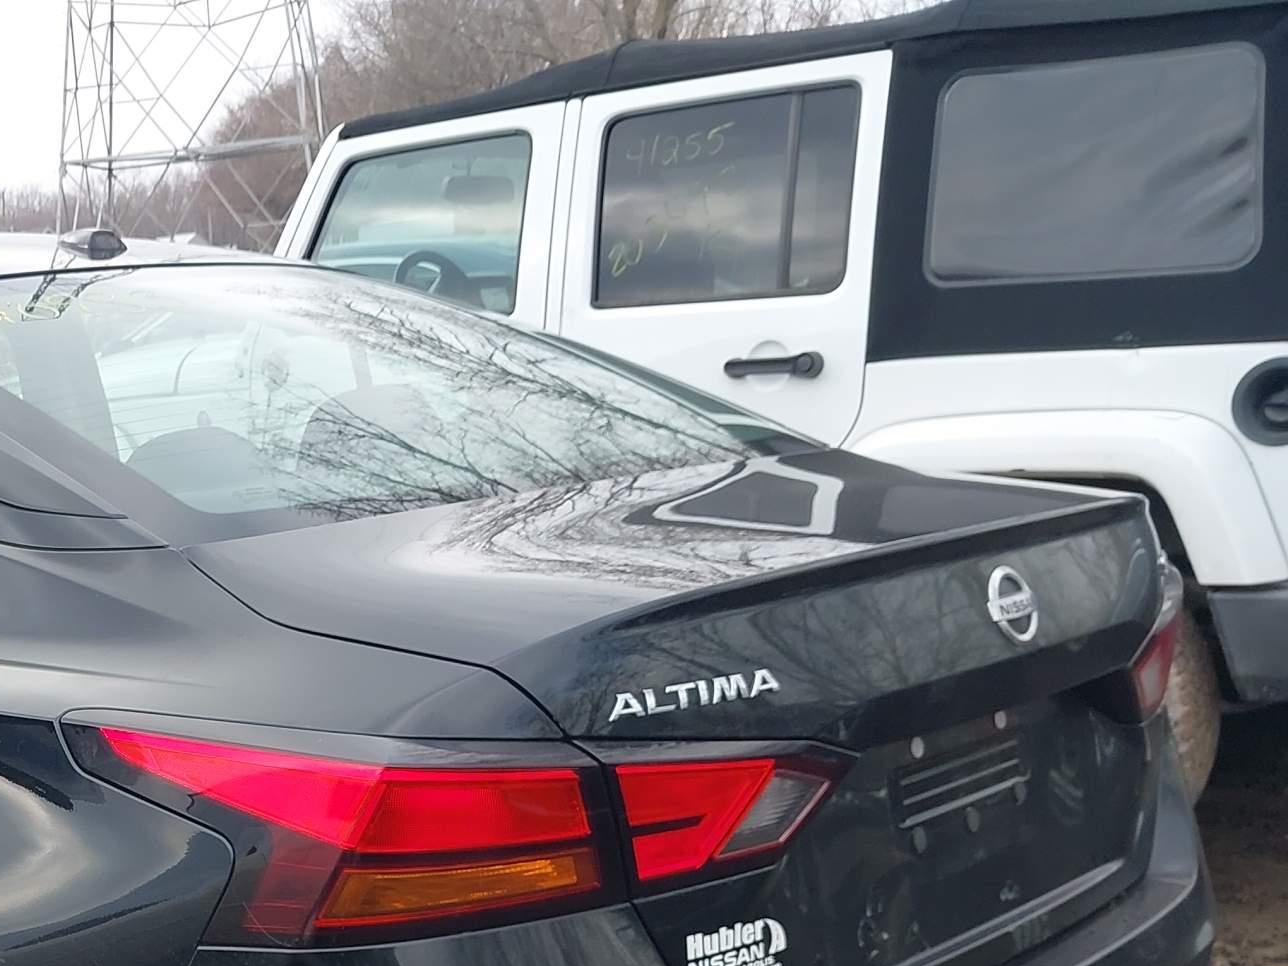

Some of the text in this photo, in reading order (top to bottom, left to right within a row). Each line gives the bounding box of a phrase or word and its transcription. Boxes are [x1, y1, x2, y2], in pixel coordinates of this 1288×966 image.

[626, 122, 736, 174] 41255
[609, 668, 781, 722] ALTIMA
[686, 918, 766, 961] Hubler
